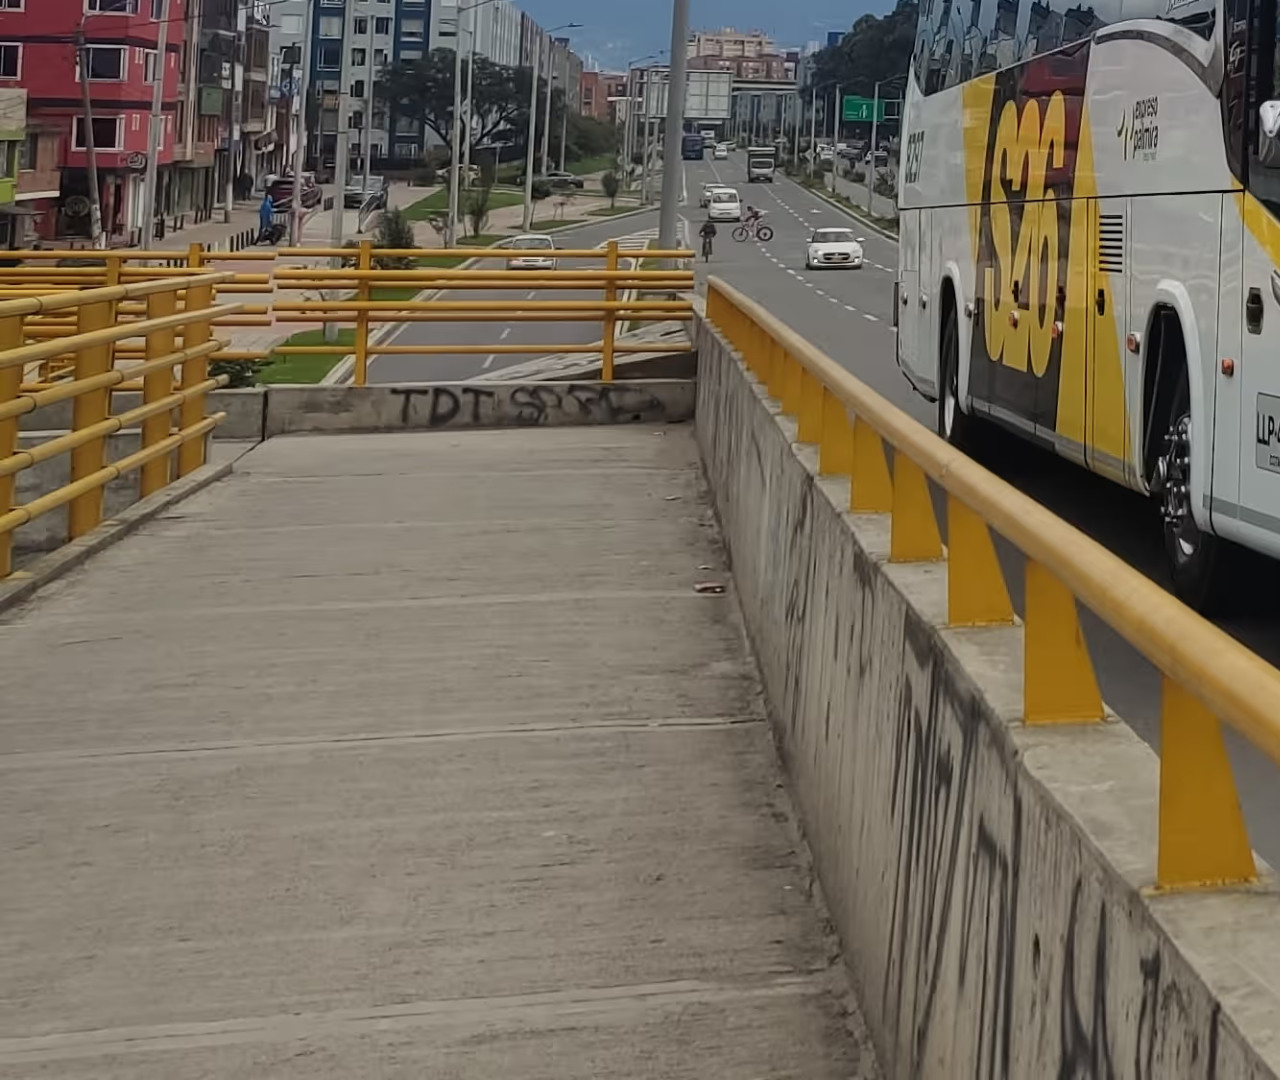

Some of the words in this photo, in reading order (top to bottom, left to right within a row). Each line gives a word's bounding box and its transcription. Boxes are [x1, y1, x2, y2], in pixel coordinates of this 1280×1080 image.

[905, 130, 925, 184] 8297
[1132, 120, 1158, 159] palmira
[984, 90, 1065, 377] S26
[390, 387, 494, 424] TDT
